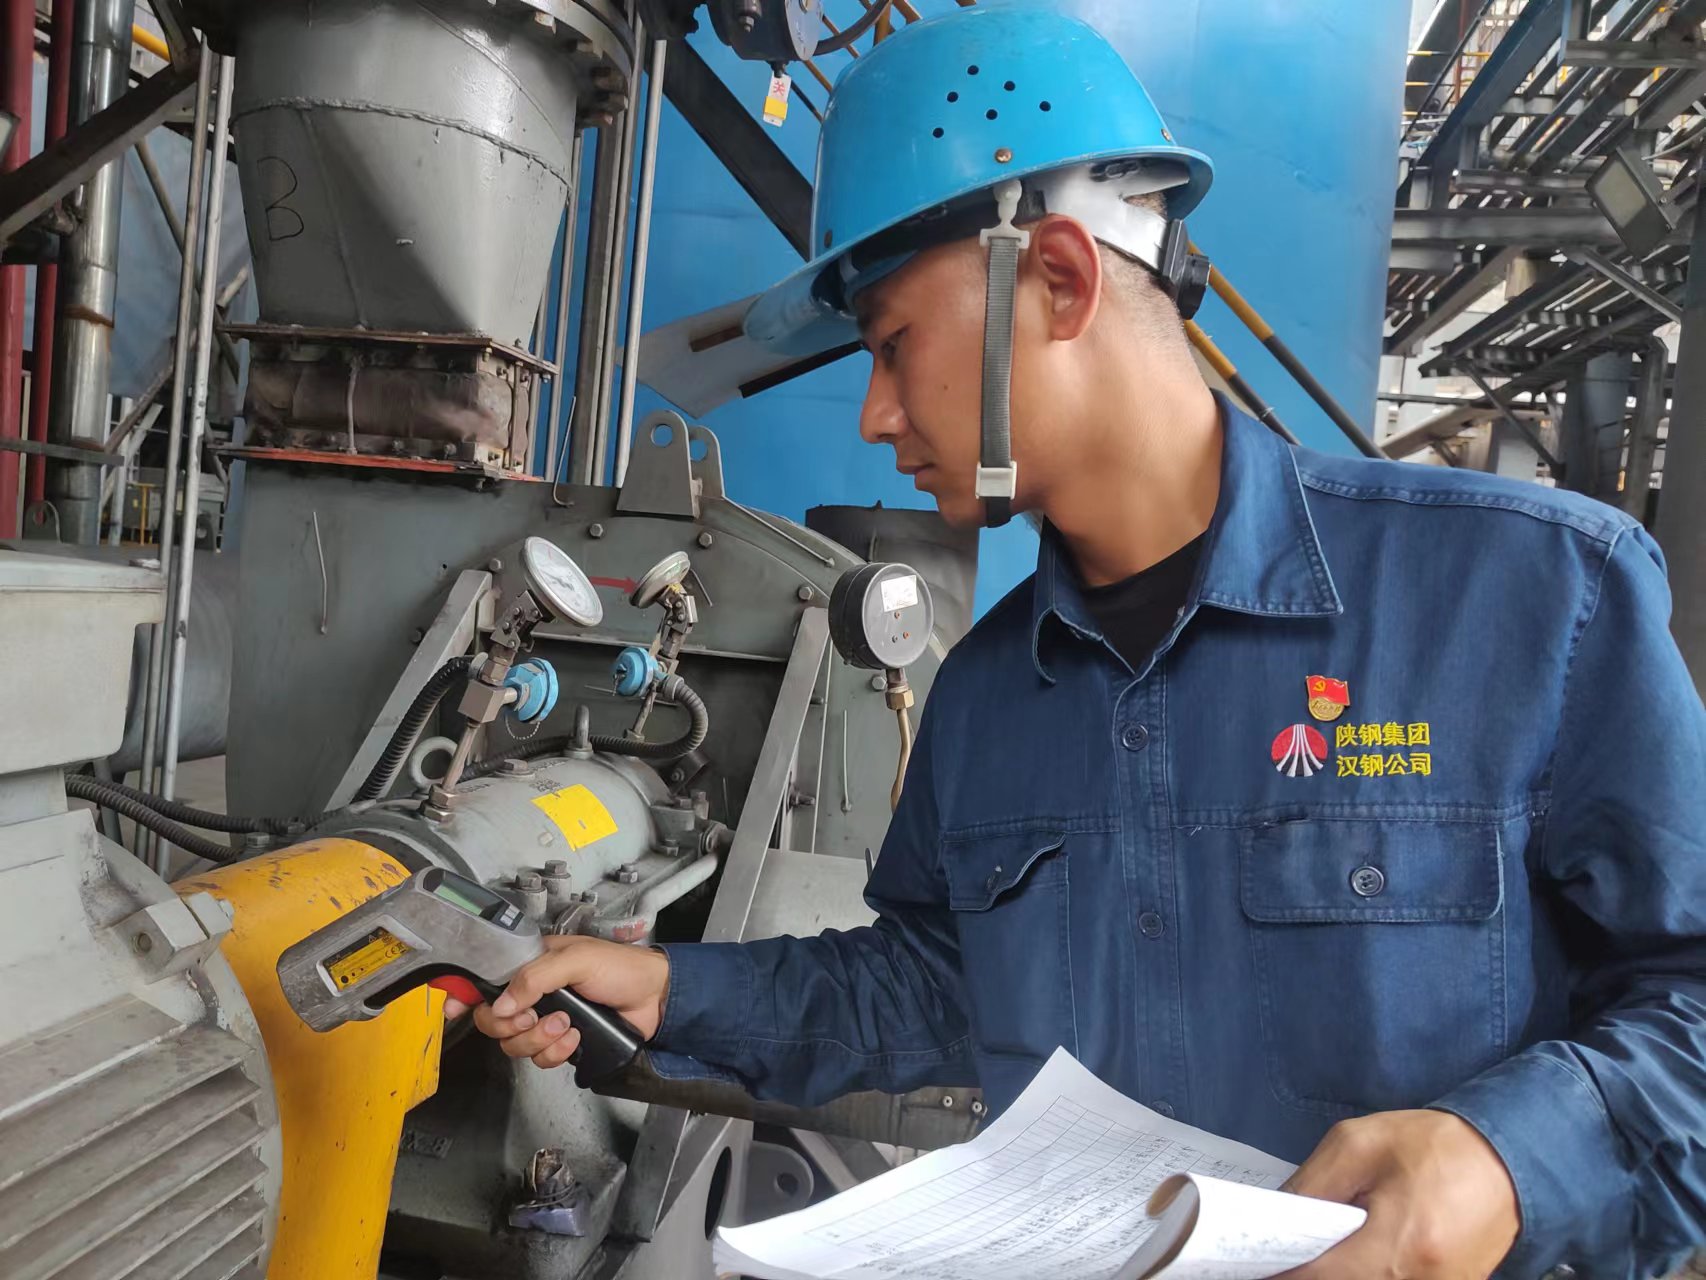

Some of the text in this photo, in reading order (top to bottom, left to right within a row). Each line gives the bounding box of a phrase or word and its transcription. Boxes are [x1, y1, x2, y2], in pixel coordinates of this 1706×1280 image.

[1335, 721, 1431, 748] 陕钢集团
[1336, 752, 1432, 778] 汉钢公司
